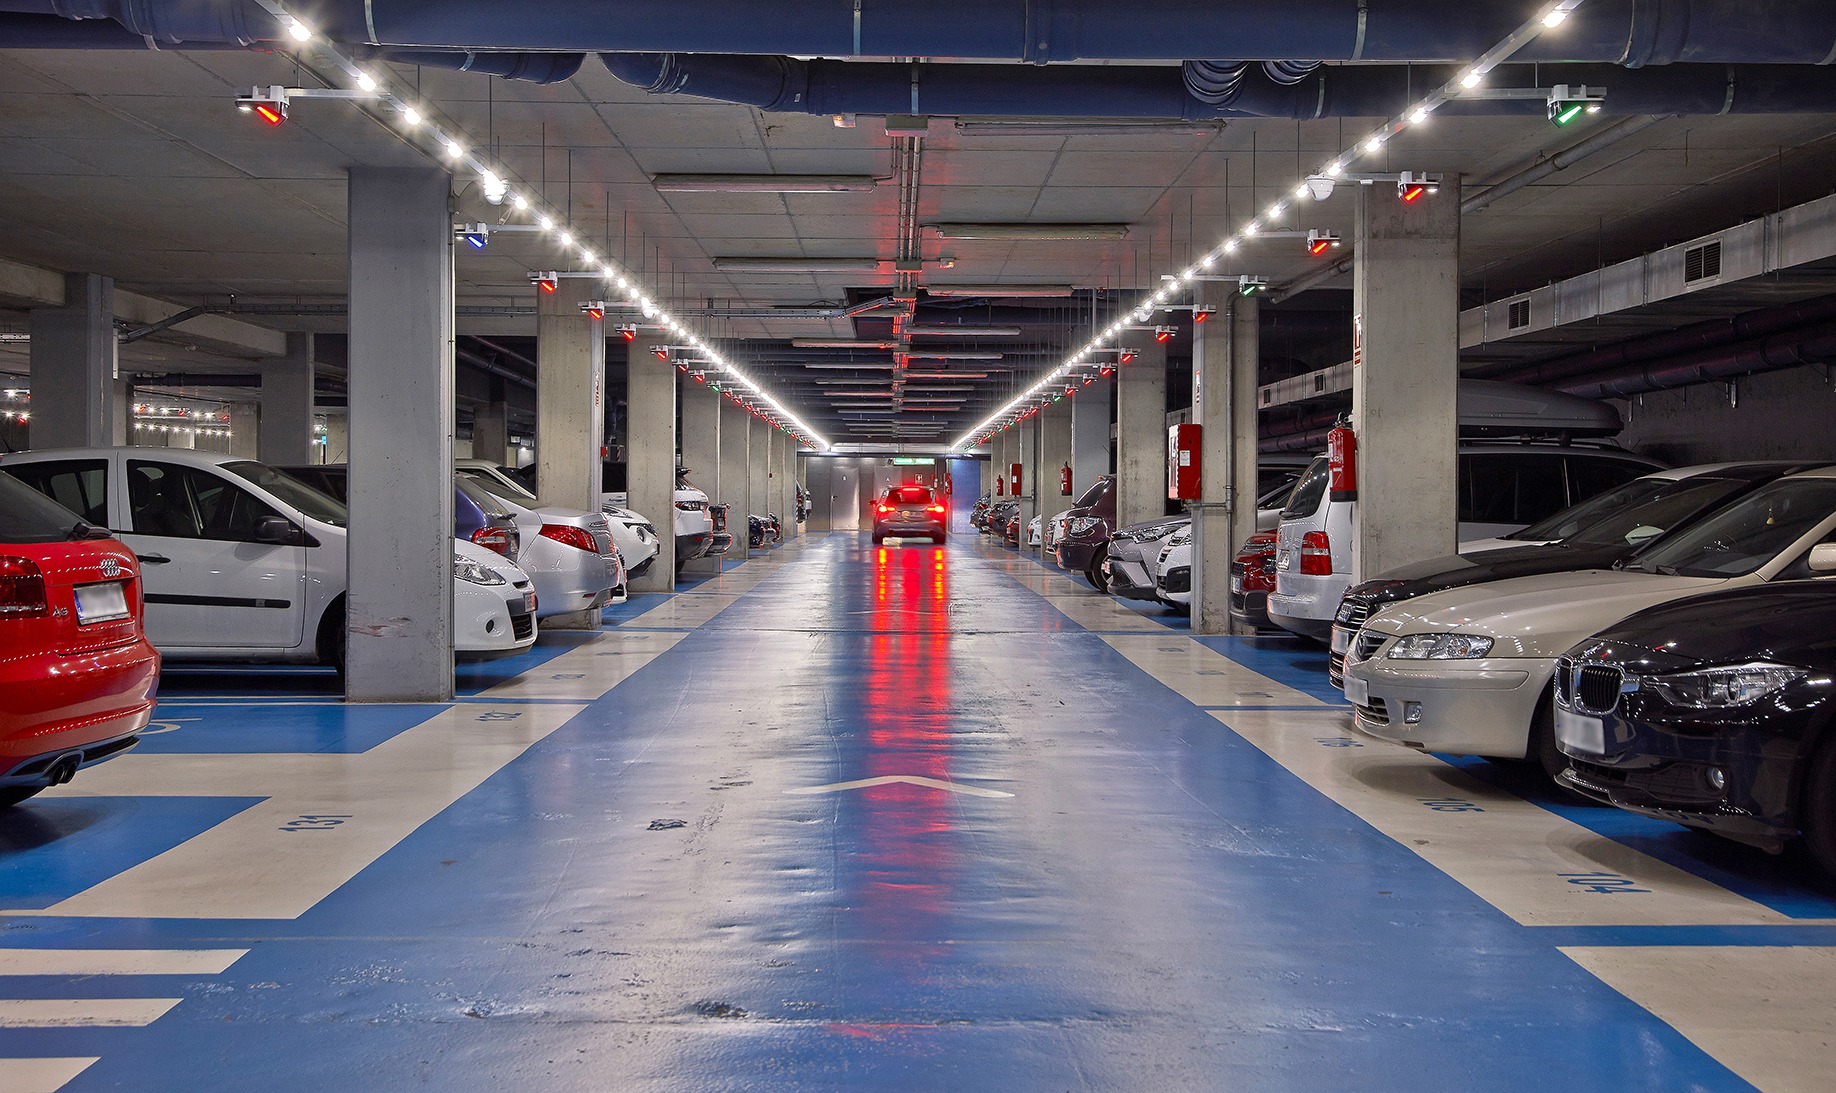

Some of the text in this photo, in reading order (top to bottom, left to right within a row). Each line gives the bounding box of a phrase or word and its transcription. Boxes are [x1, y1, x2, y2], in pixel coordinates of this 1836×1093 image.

[52, 605, 69, 617] A3
[1416, 797, 1486, 812] 105
[278, 814, 354, 832] 131
[1556, 871, 1653, 894] 104
